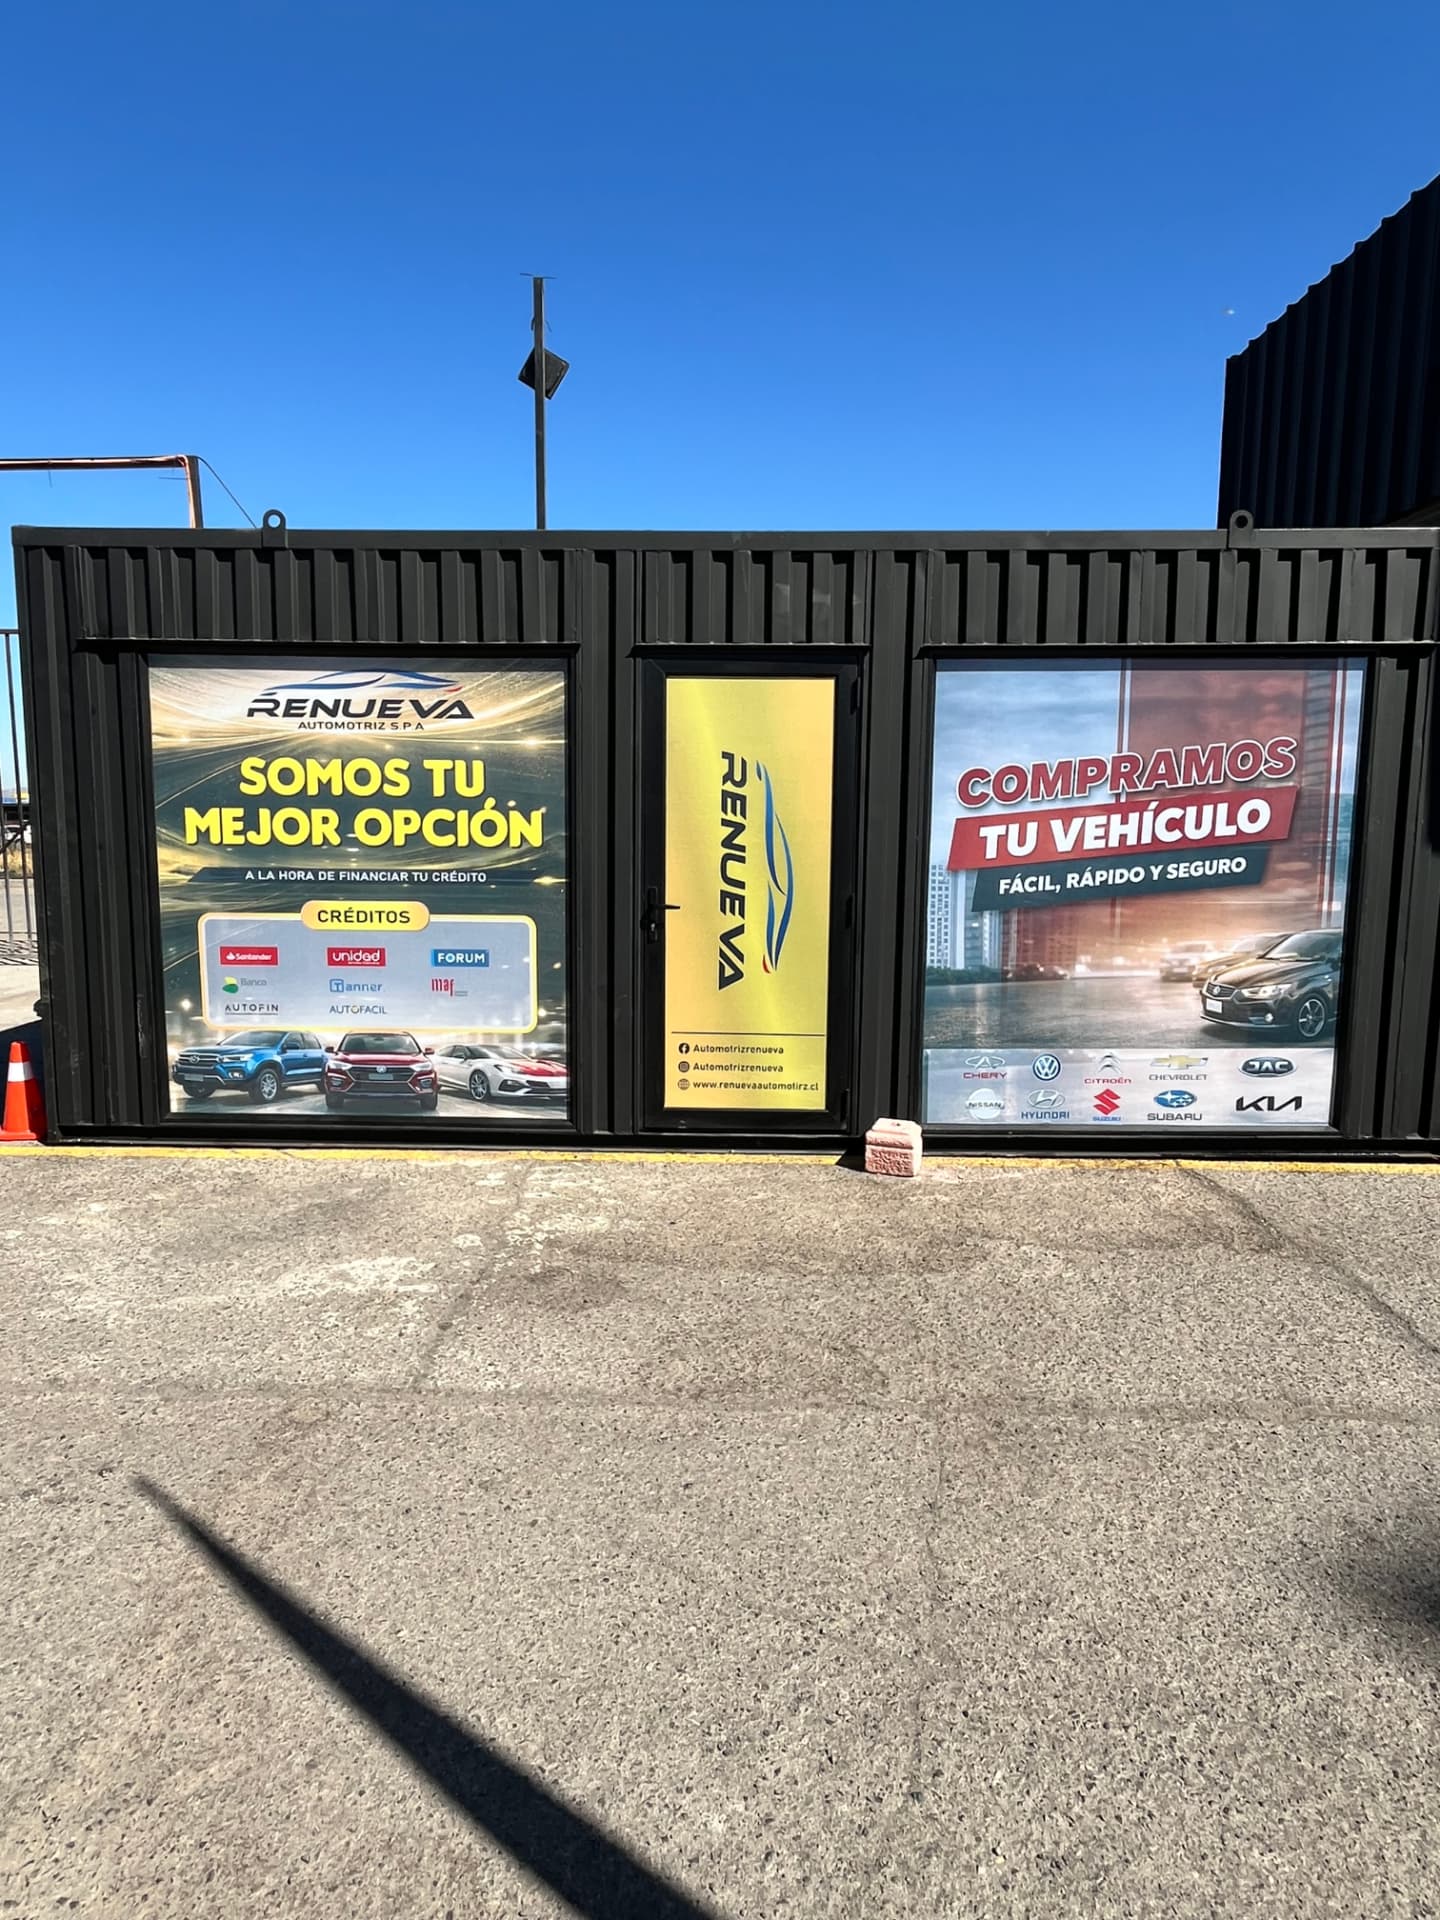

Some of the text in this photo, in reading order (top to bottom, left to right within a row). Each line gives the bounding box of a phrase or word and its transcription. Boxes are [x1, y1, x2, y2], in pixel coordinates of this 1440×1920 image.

[247, 697, 474, 720] RENUEVA
[298, 721, 386, 731] AUTOMOTRIZ
[239, 756, 485, 798] SOMOS TU
[956, 736, 1298, 808] COMPRAMOS
[184, 797, 544, 849] MEJOR OPCIÓN
[978, 796, 1273, 860] TU VEHÍCULO
[245, 869, 487, 883] A LA HORA DE FINANCIAR TU CRÉDITO
[717, 751, 748, 991] RENUEVA
[998, 856, 1248, 896] FÁCIL, RÁPIDO Y SEGURO
[317, 907, 411, 924] CRÉDITOS
[235, 953, 272, 961] Santander
[437, 952, 486, 963] FORUM
[329, 978, 382, 993] Tanner
[431, 978, 455, 997] maf
[225, 1003, 279, 1012] AUTOFIN
[329, 1005, 388, 1015] AUTOFACIL
[693, 1043, 784, 1055] Automotrizrenueva
[693, 1062, 784, 1073] Automotrizrenueva
[1247, 1060, 1289, 1072] JAC
[1148, 1073, 1208, 1081] CHEVROLET
[1235, 1095, 1303, 1112] KIA
[1020, 1111, 1070, 1120] HYUNDAI
[1147, 1113, 1203, 1121] SUBARU
